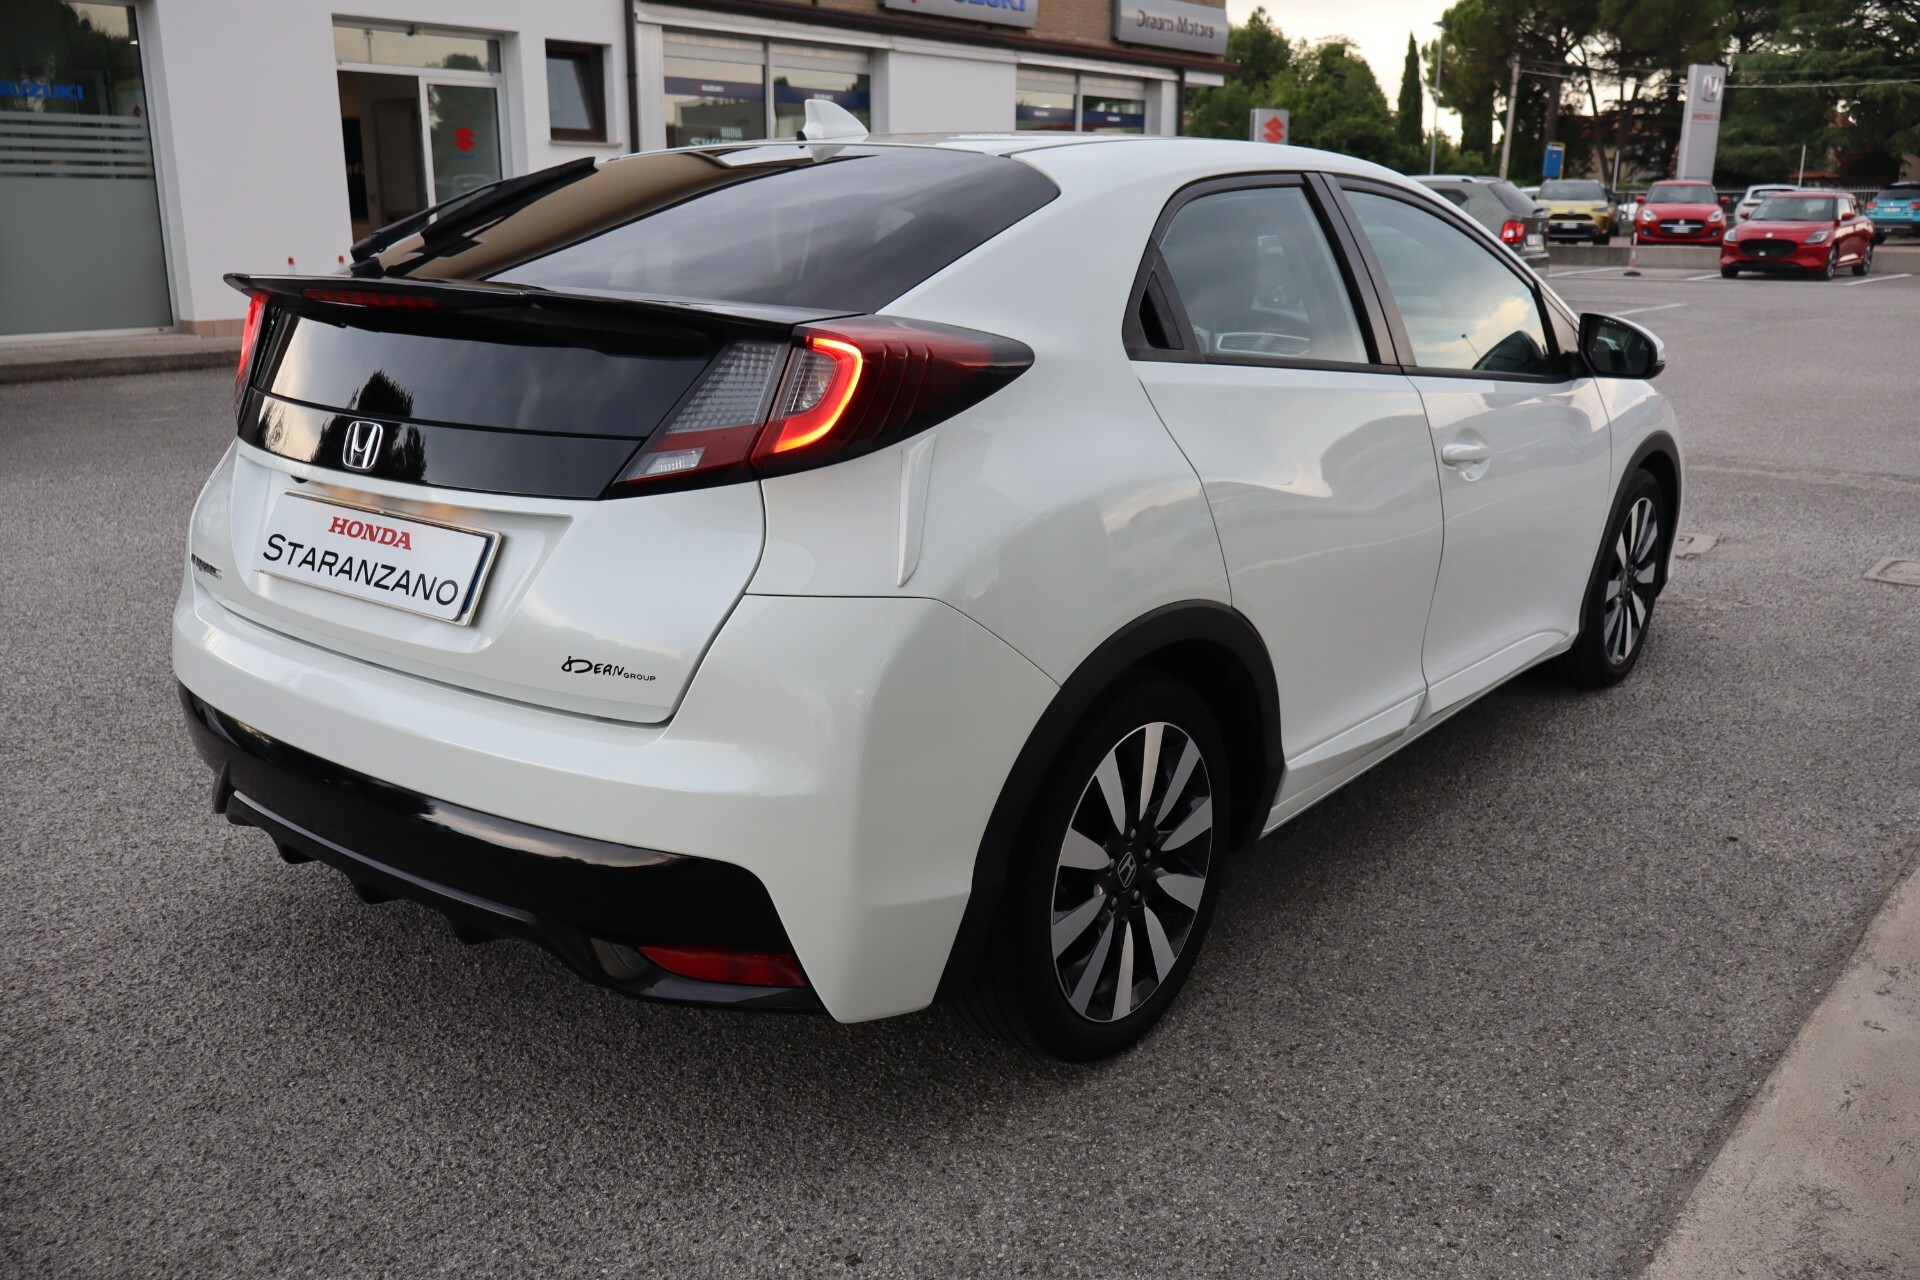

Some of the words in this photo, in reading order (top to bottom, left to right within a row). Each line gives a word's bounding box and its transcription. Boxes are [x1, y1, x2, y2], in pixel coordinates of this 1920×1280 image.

[1137, 9, 1174, 32] Dream
[1177, 15, 1215, 39] Motors
[328, 516, 412, 550] HONDA
[263, 533, 459, 606] STARANZANO
[561, 655, 625, 677] DEAN
[623, 672, 656, 682] GROUP
